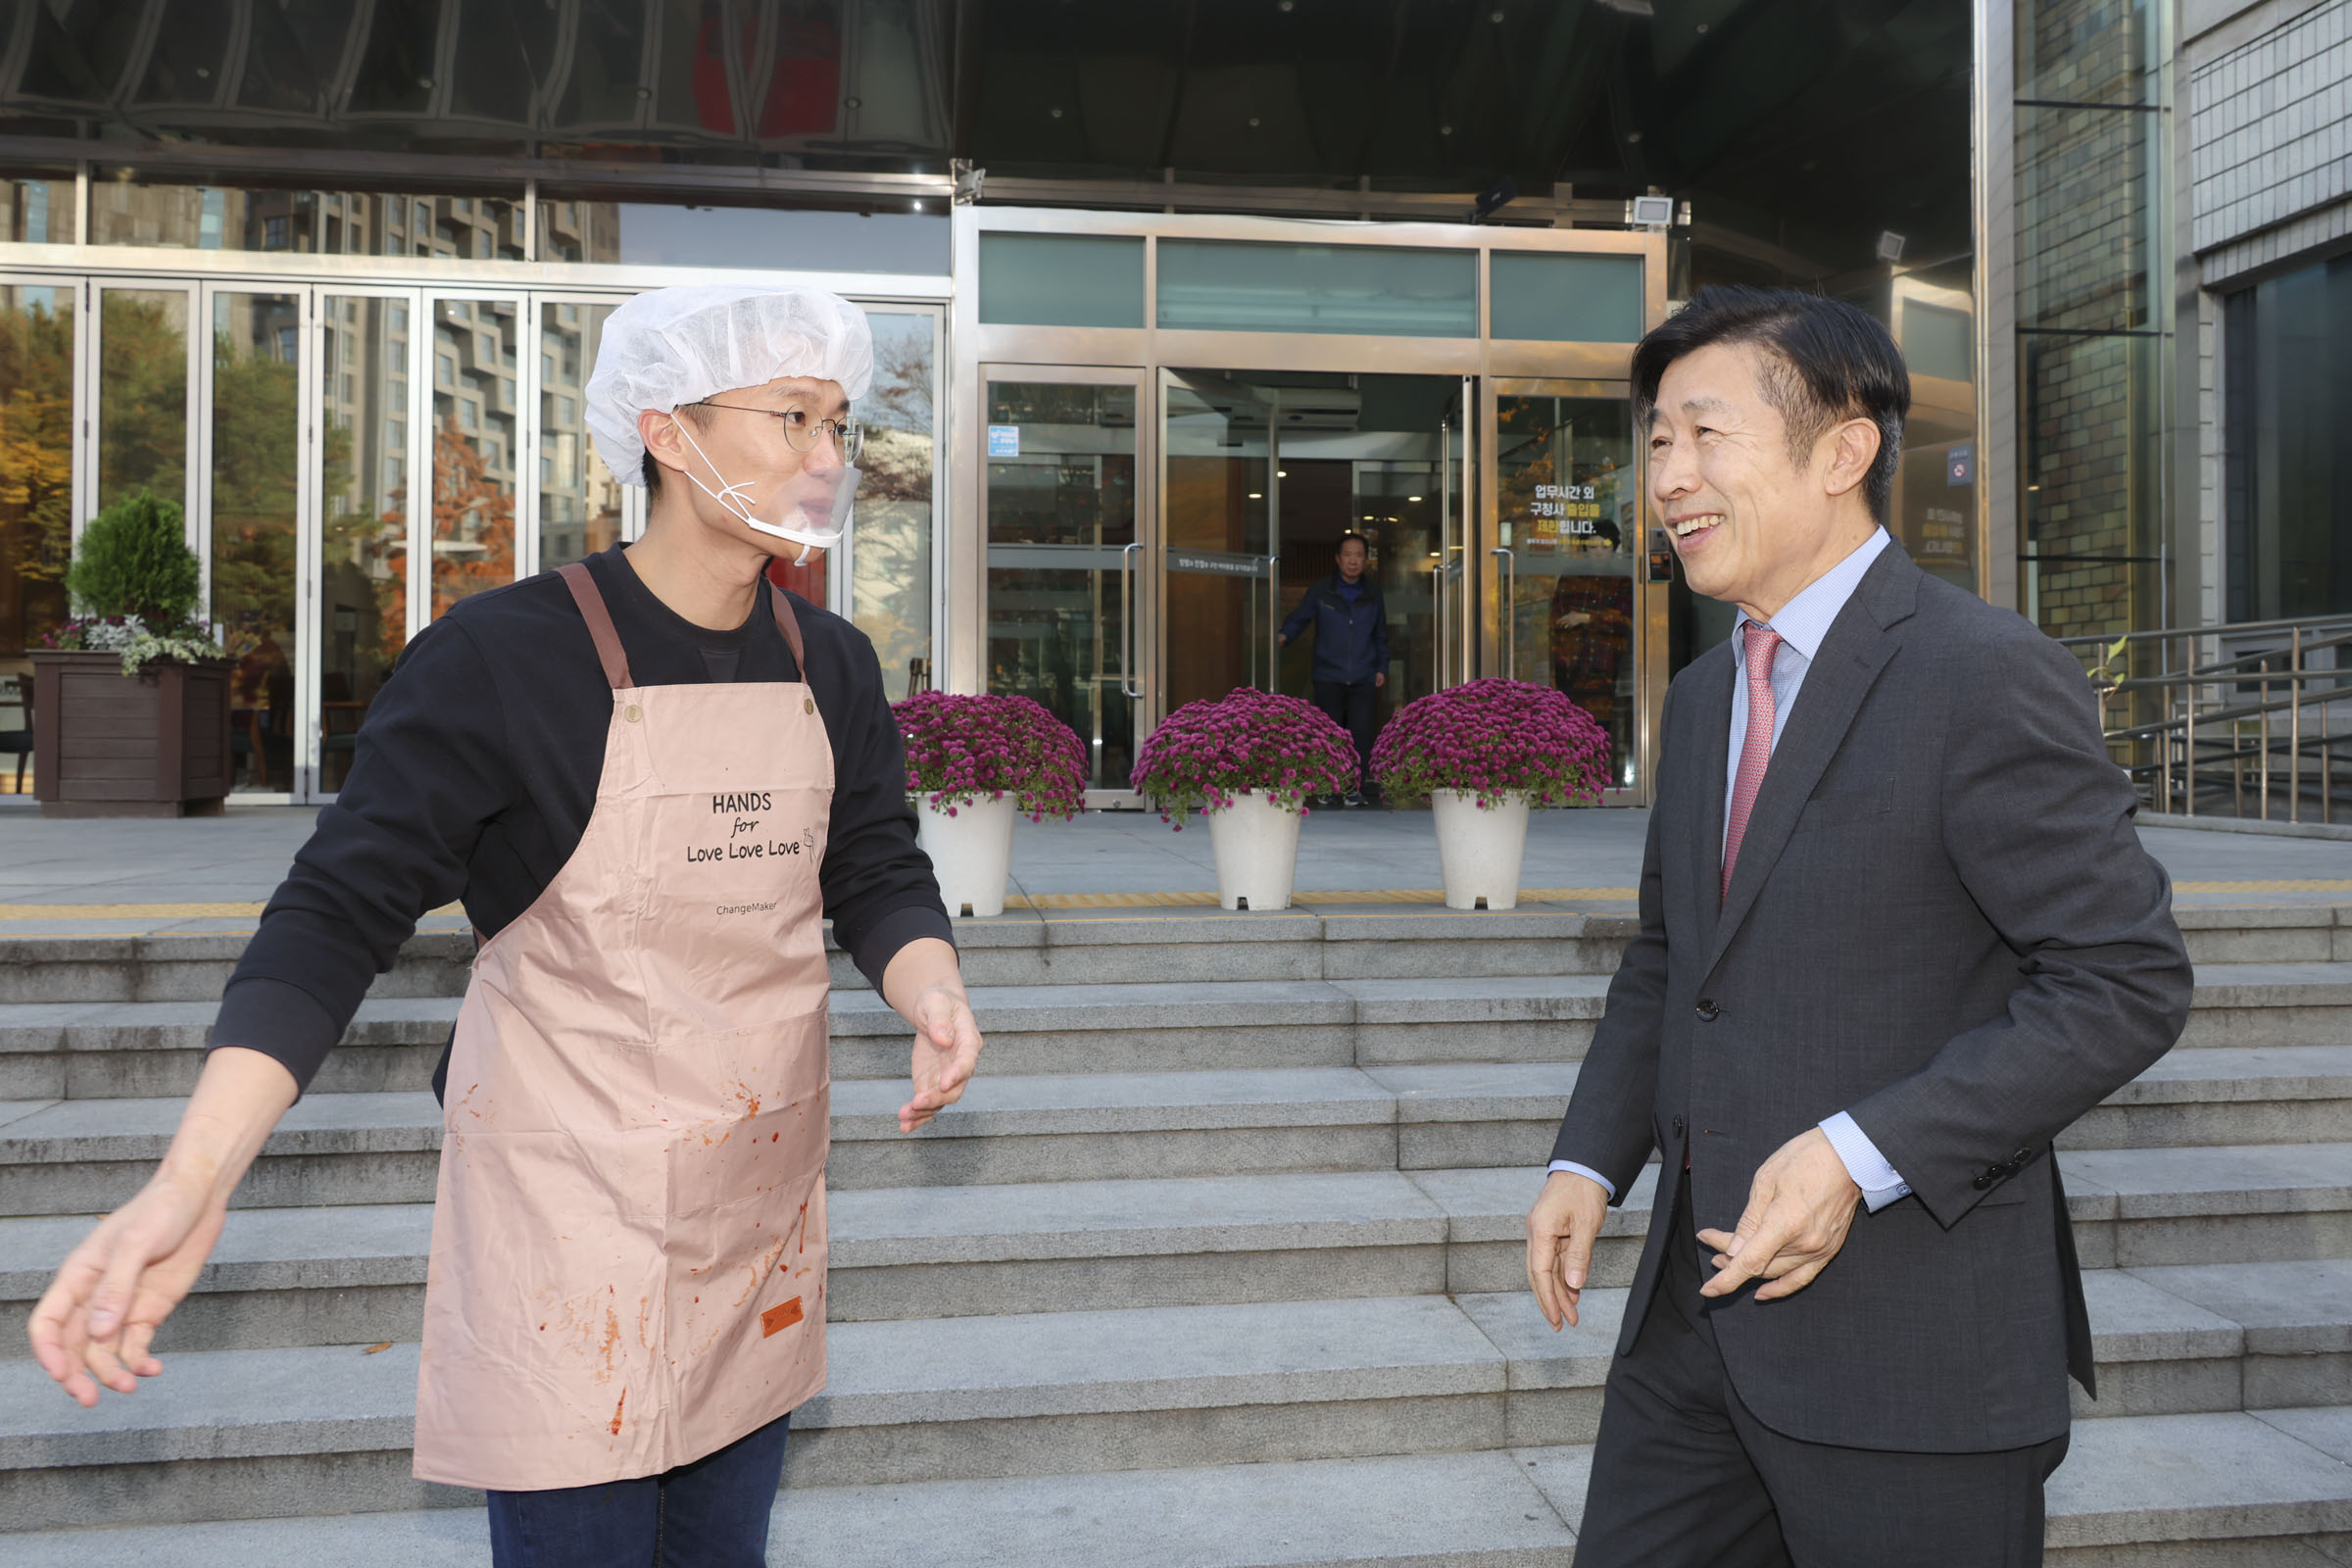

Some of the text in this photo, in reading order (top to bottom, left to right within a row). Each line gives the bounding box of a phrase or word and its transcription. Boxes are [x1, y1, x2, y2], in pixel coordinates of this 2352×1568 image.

[1535, 484, 1594, 500] 업무시간 외
[1530, 502, 1565, 516] 구청사
[712, 792, 772, 814] HANDS
[730, 816, 760, 839] for
[687, 840, 800, 862] Love Love Love
[716, 901, 777, 915] ChangeMaker
